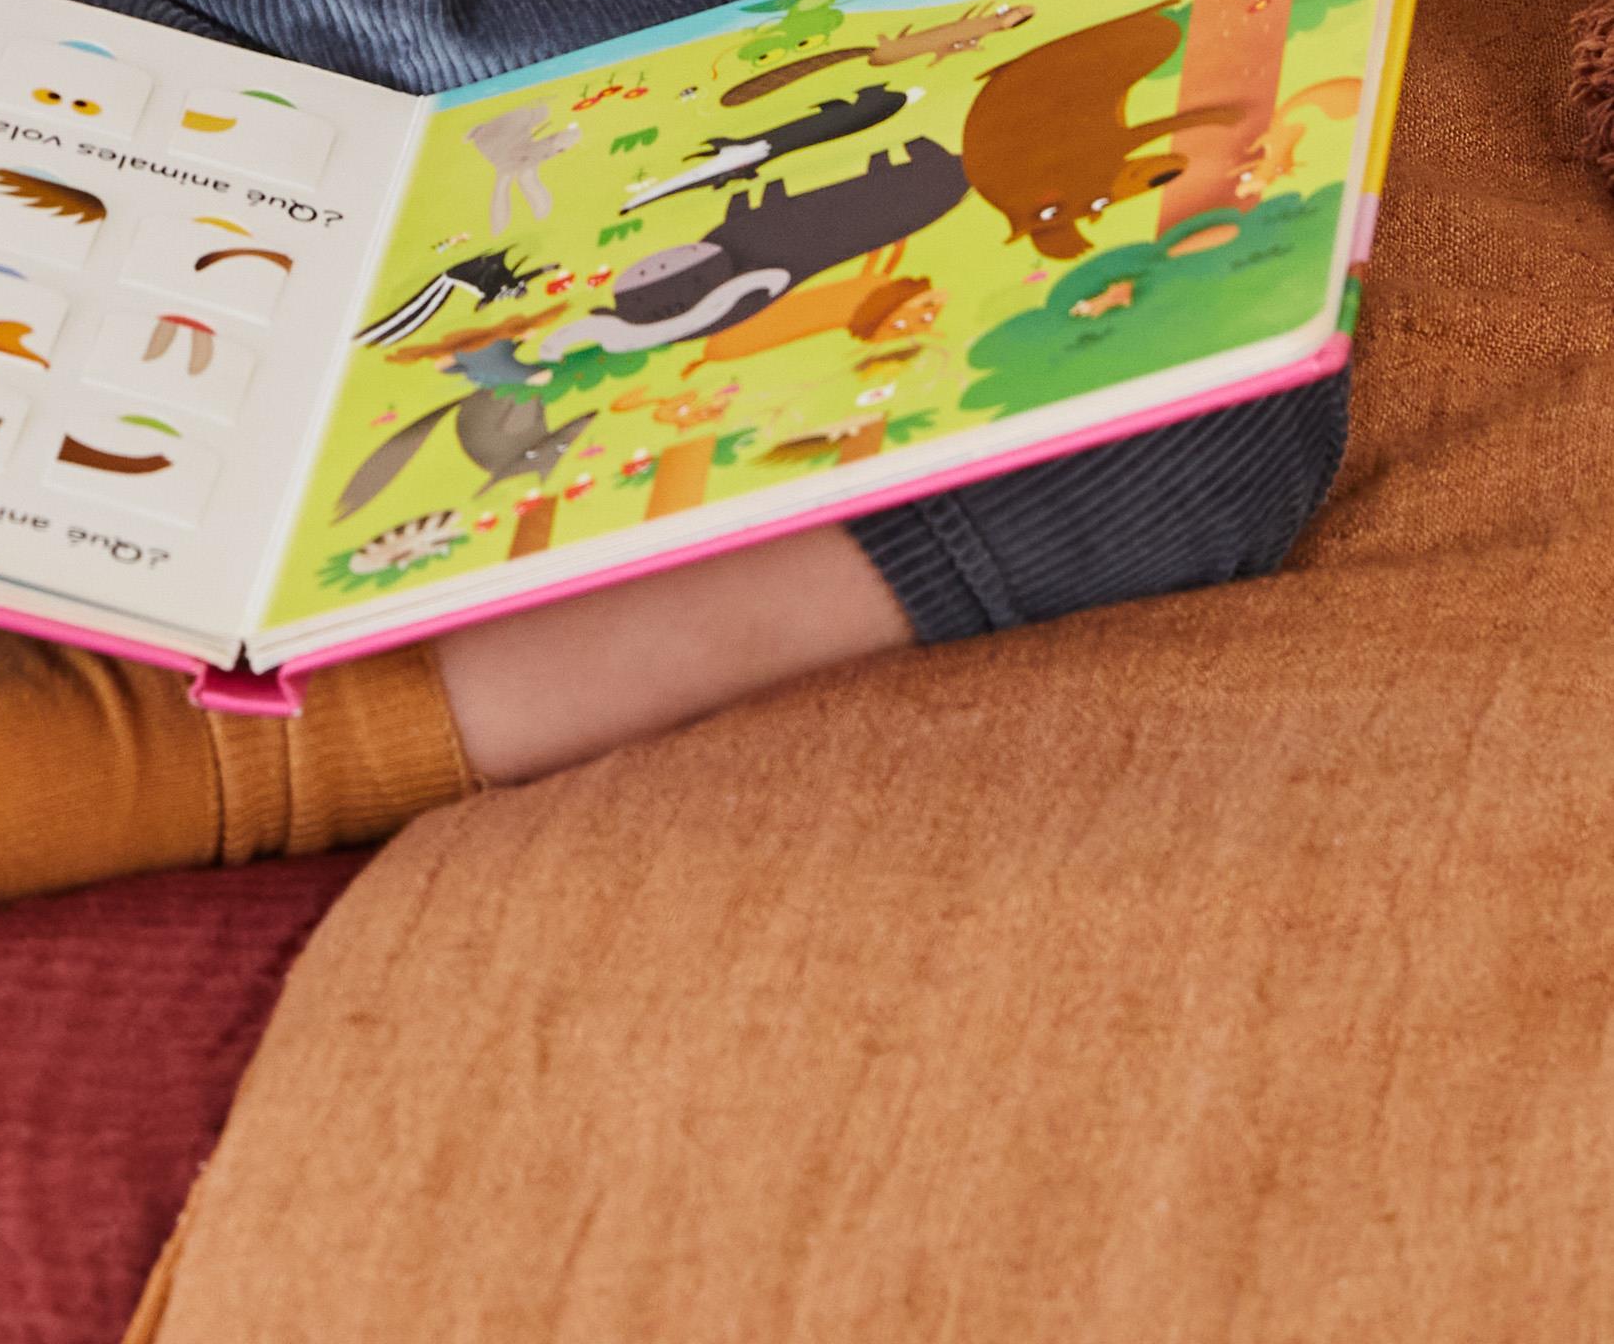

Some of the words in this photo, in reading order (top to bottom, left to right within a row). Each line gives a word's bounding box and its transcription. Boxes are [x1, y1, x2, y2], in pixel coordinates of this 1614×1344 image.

[76, 140, 231, 194] animales
[246, 187, 344, 228] ¿Qué
[66, 526, 170, 570] ¿Qué
